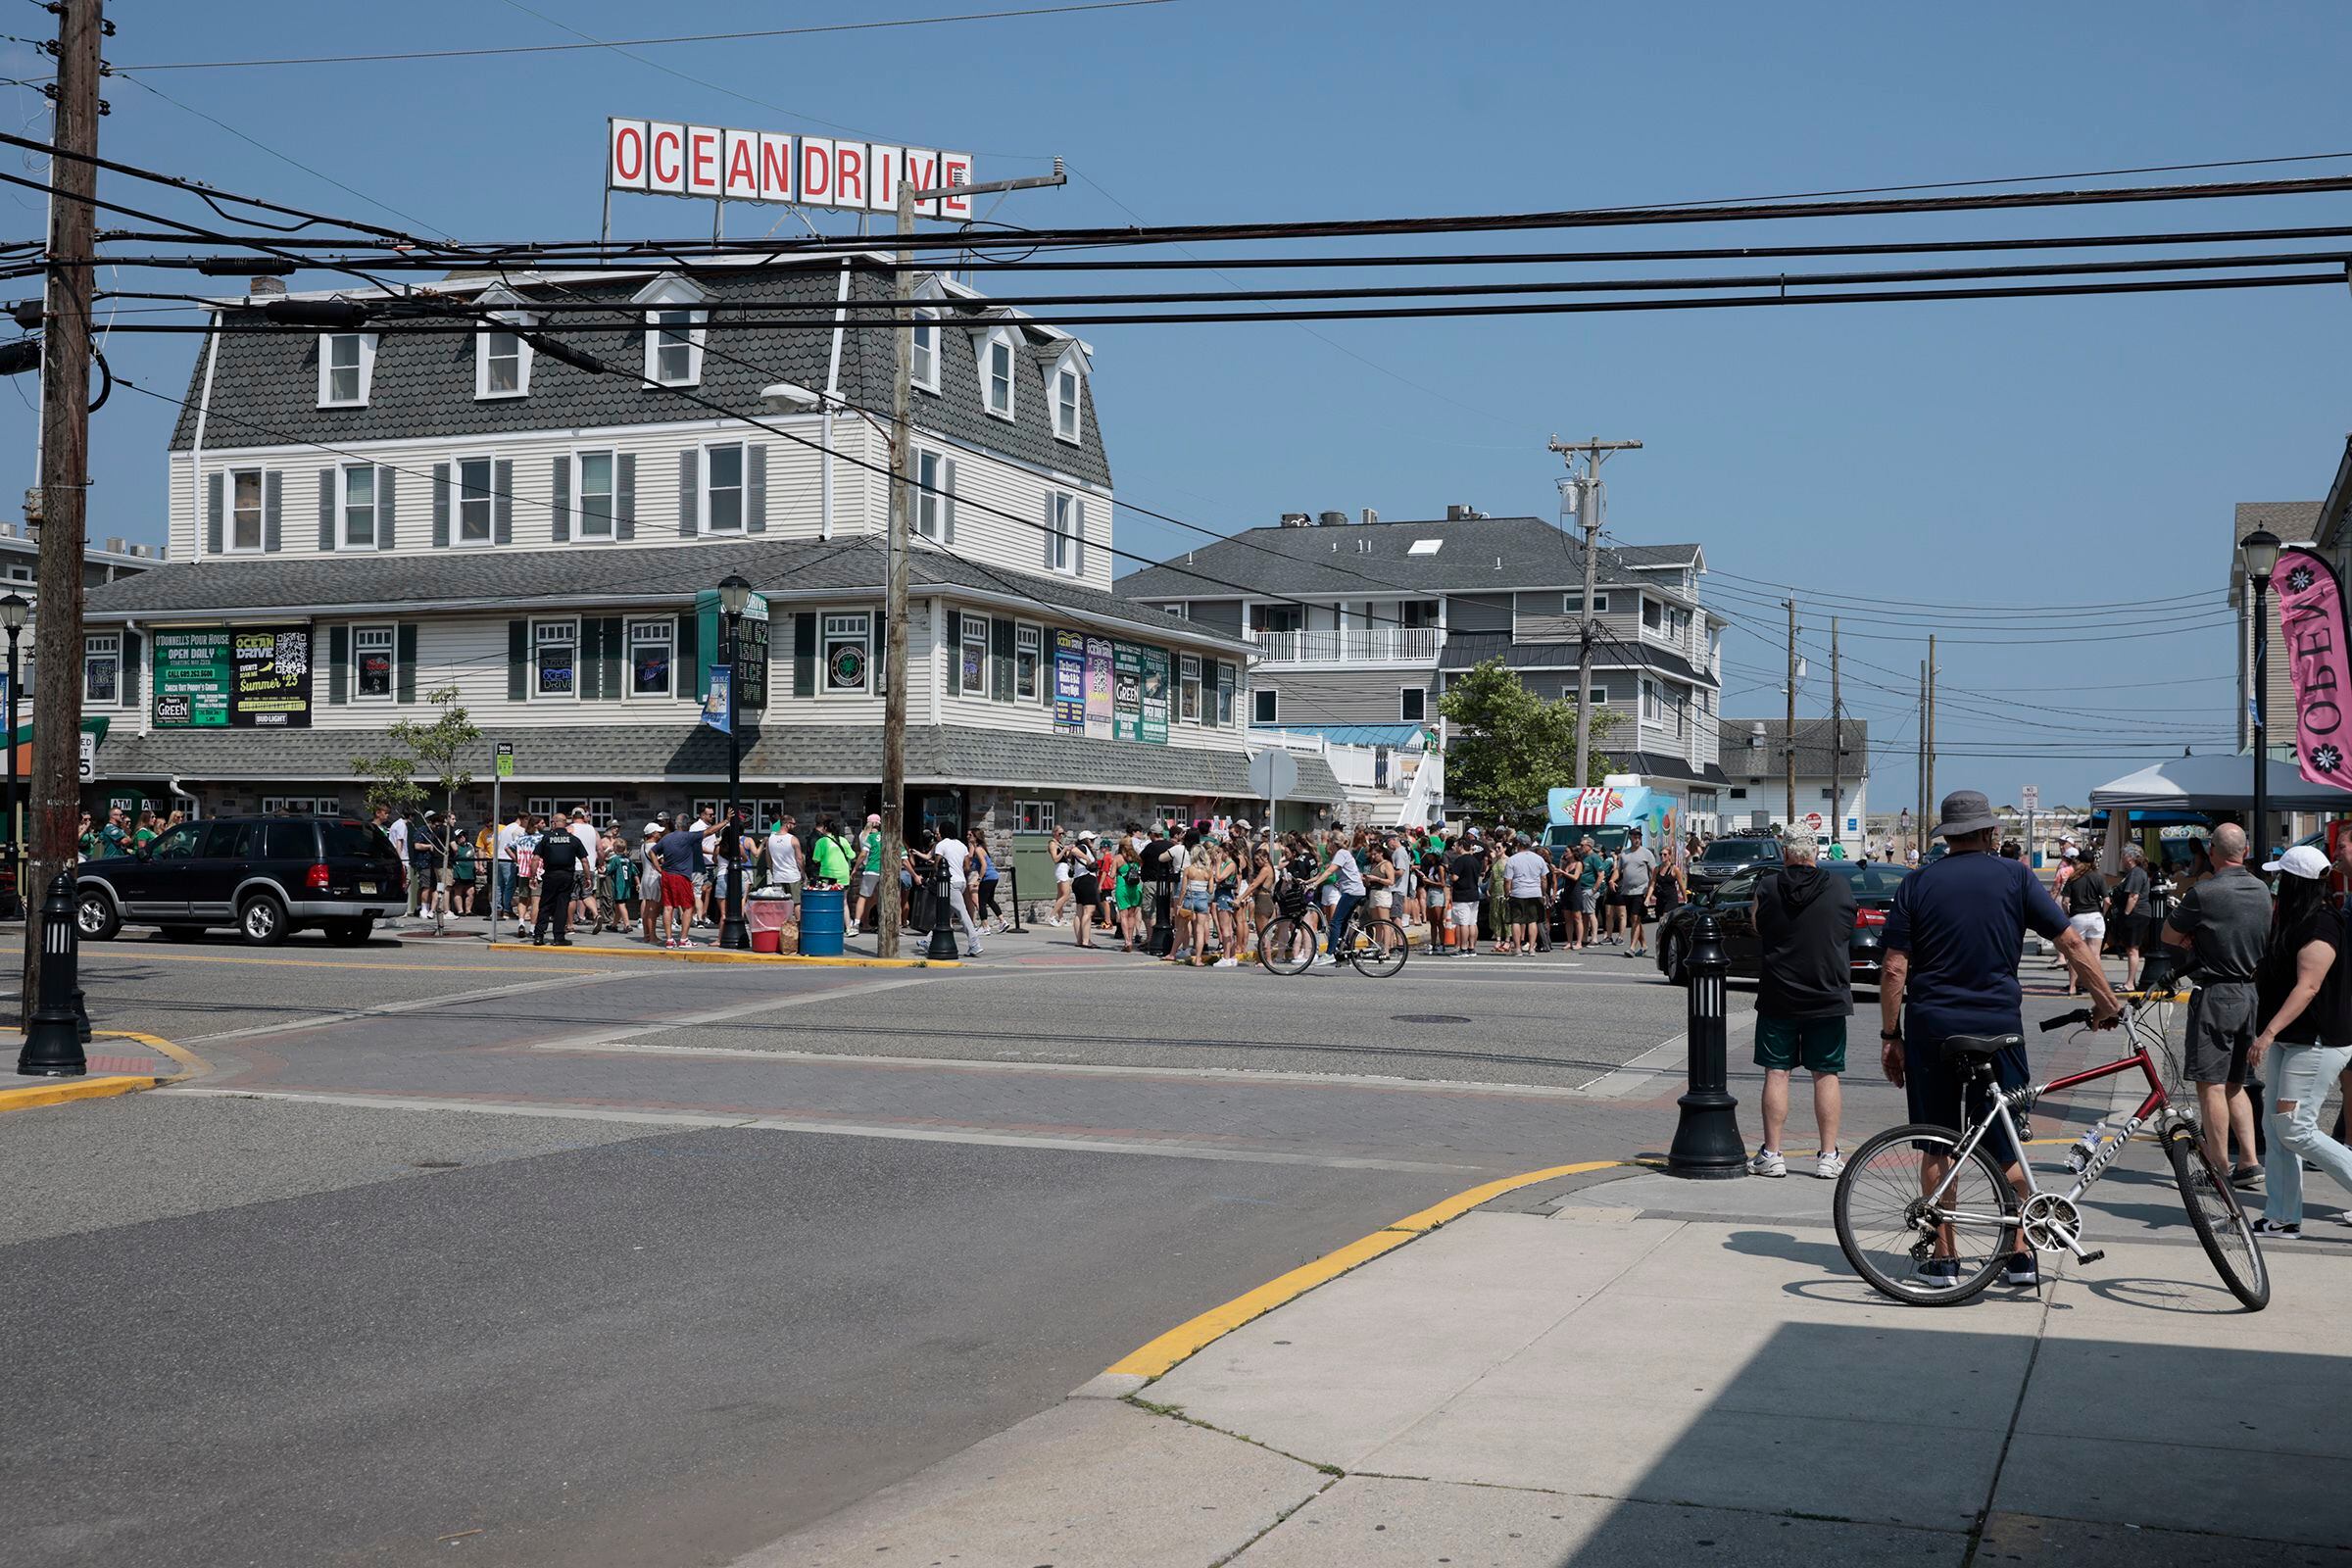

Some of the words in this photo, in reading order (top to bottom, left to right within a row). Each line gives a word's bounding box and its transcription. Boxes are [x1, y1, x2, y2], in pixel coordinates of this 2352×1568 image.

[615, 126, 789, 192] OCEAN
[156, 635, 190, 646] O'DONNELL'S
[190, 634, 207, 646] POUR
[208, 633, 230, 645] HOUSE
[236, 637, 274, 648] OCEAN
[168, 648, 189, 660] OPEN
[191, 648, 215, 659] DAILY
[236, 647, 274, 659] DRIVE
[2290, 587, 2342, 735] OPEN
[739, 662, 762, 683] ELCE
[240, 677, 281, 692] Summer
[1117, 682, 1139, 703] GREEN
[158, 703, 187, 716] GREEN
[112, 799, 131, 810] ATM
[142, 799, 163, 810] ATM
[621, 865, 628, 880] 6
[2078, 1123, 2135, 1189] Raleigh
